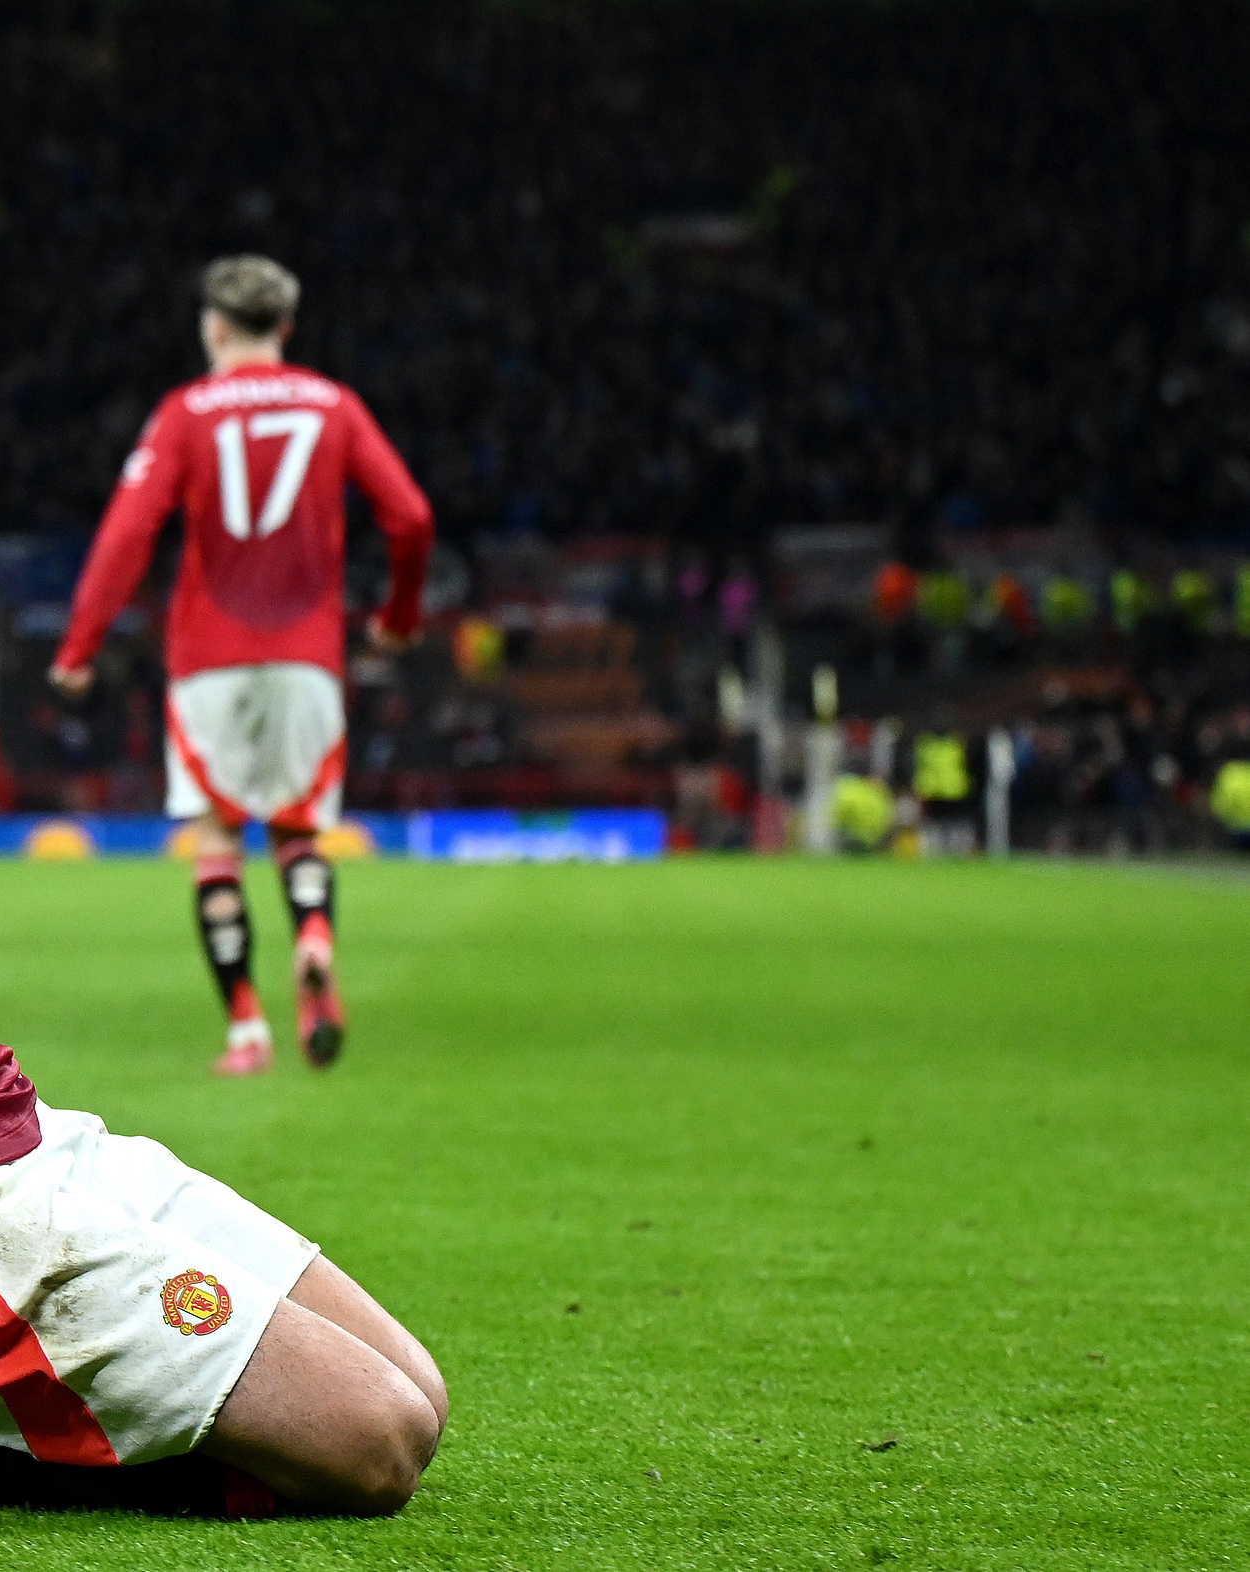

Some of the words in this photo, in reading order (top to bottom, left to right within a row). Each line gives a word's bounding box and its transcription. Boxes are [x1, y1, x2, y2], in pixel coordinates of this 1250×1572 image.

[214, 411, 324, 540] 17
[165, 1274, 199, 1322] MANCHESTER
[207, 1295, 229, 1329] UNITED
